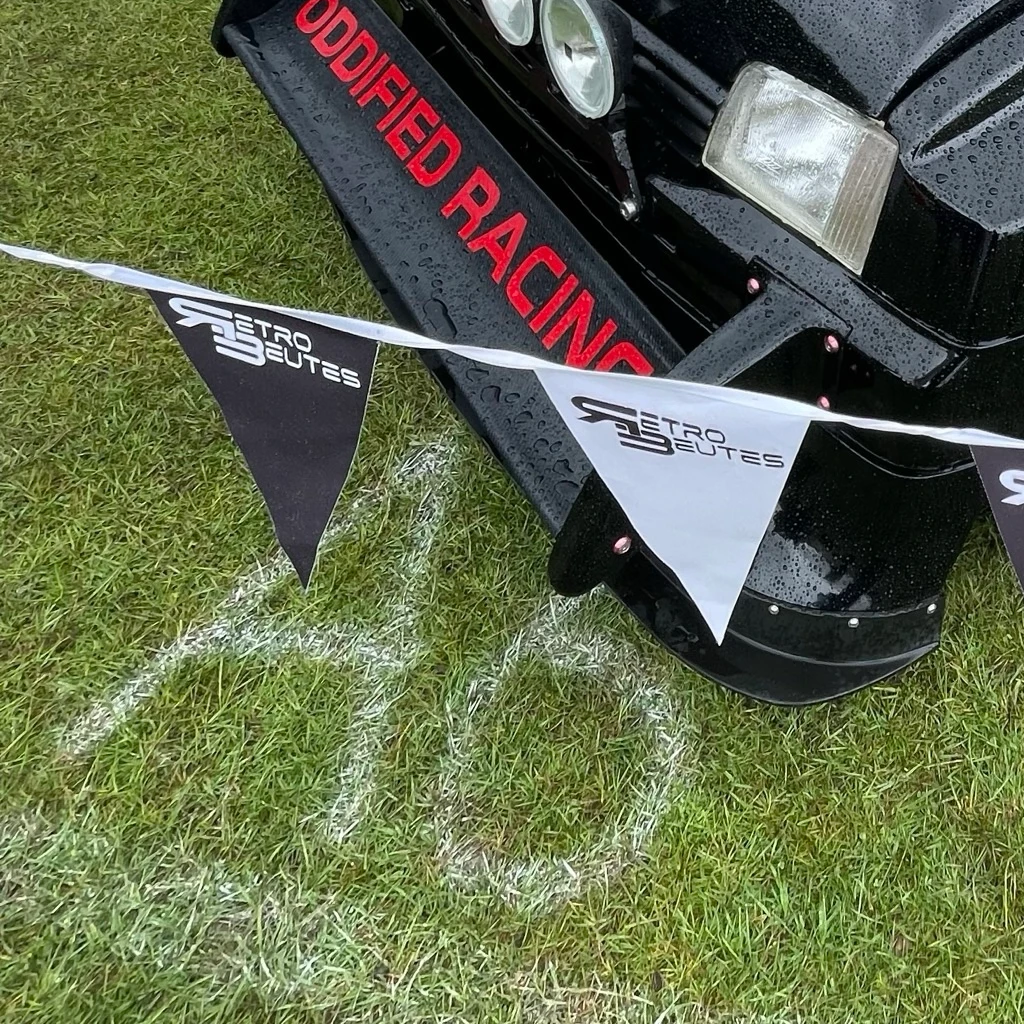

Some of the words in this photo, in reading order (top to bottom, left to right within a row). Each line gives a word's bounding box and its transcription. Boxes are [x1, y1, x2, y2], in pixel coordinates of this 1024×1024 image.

[168, 297, 312, 353] RETRO
[211, 325, 361, 389] BEUTES
[570, 395, 726, 444] RETRO
[614, 423, 785, 468] BEUTES
